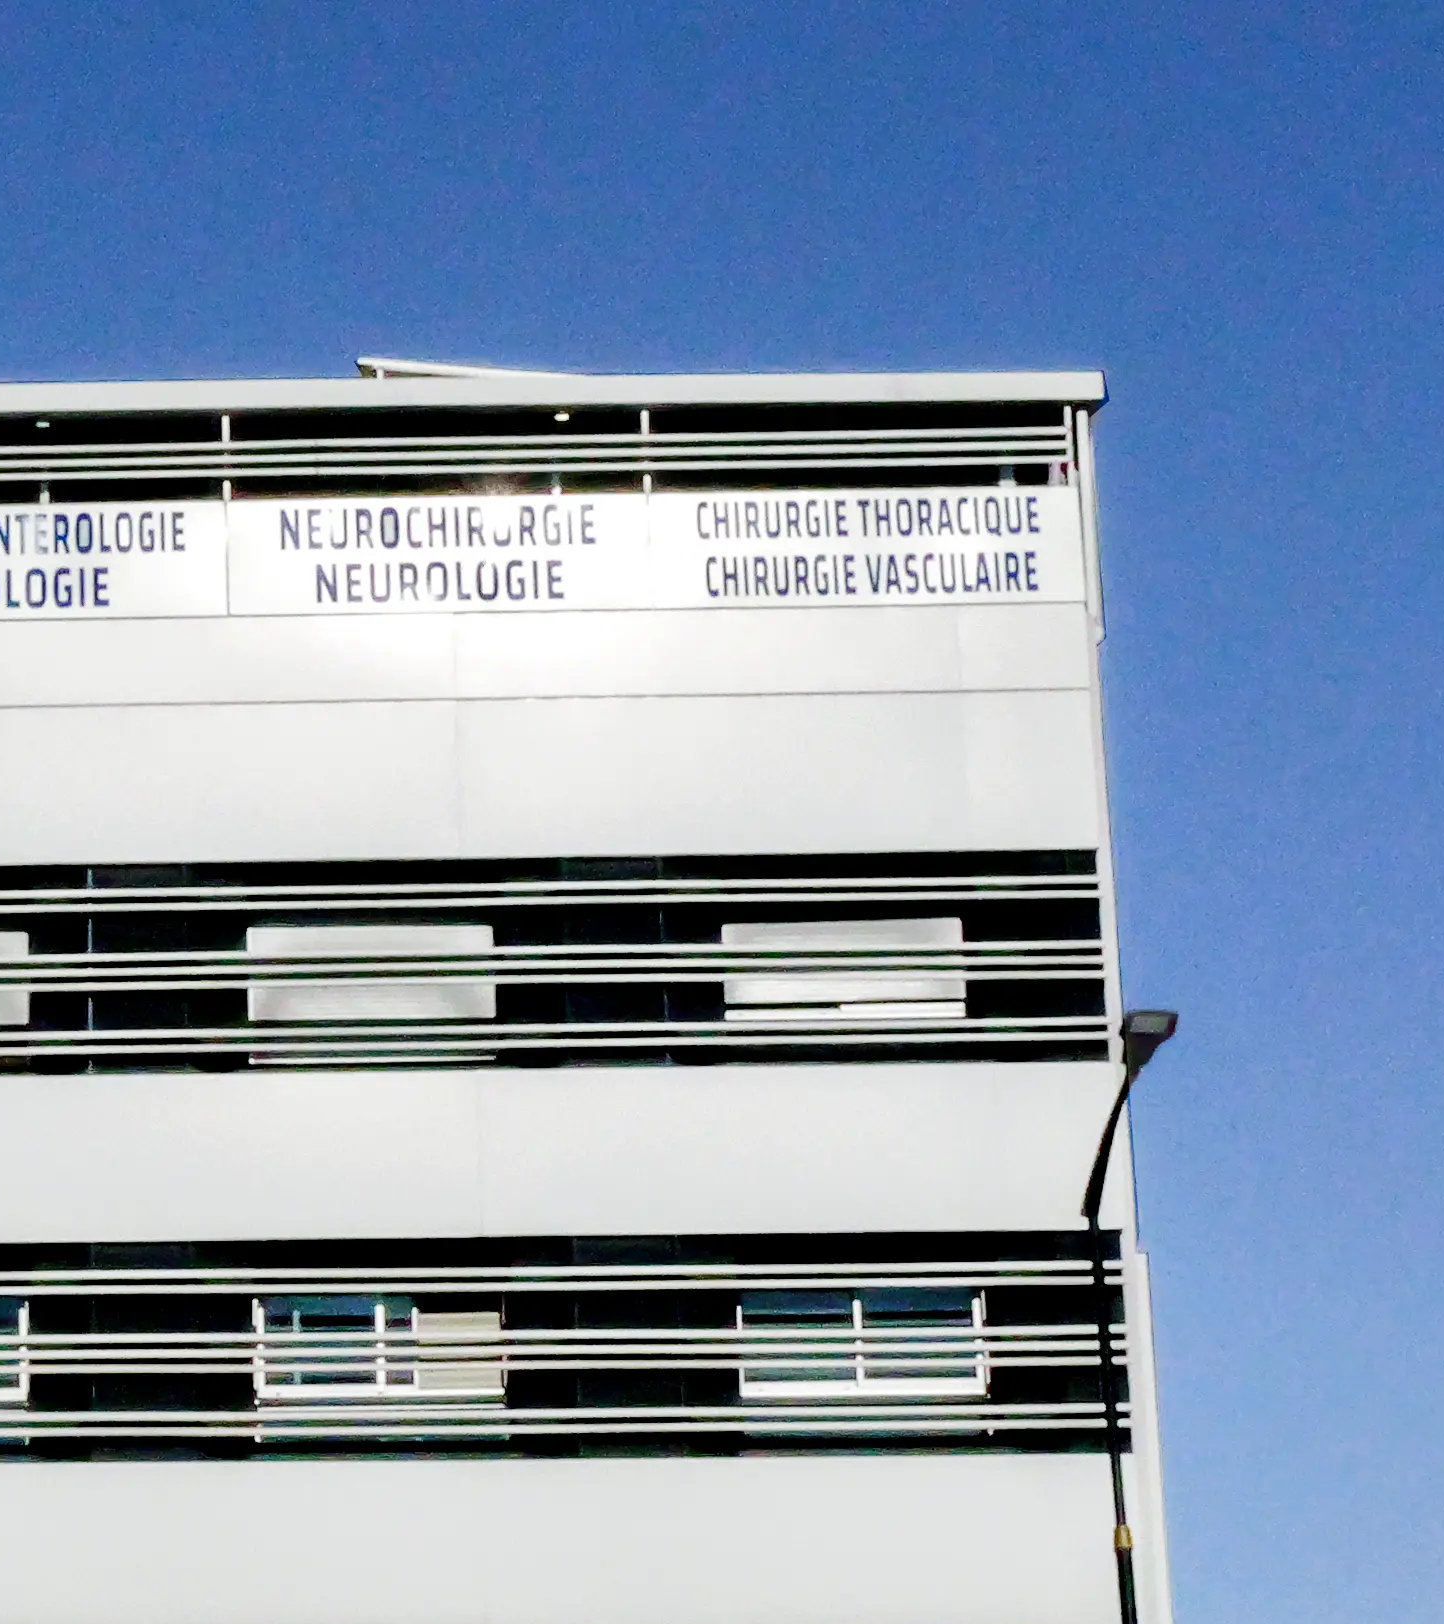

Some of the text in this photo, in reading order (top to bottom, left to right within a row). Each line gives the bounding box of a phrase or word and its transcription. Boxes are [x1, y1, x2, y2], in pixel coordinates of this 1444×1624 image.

[697, 496, 1040, 539] CHIRURGIE THORACIQUE
[316, 560, 564, 603] NEUROLOGIE
[706, 551, 1039, 597] CHIRURGIE VASCULAIRE
